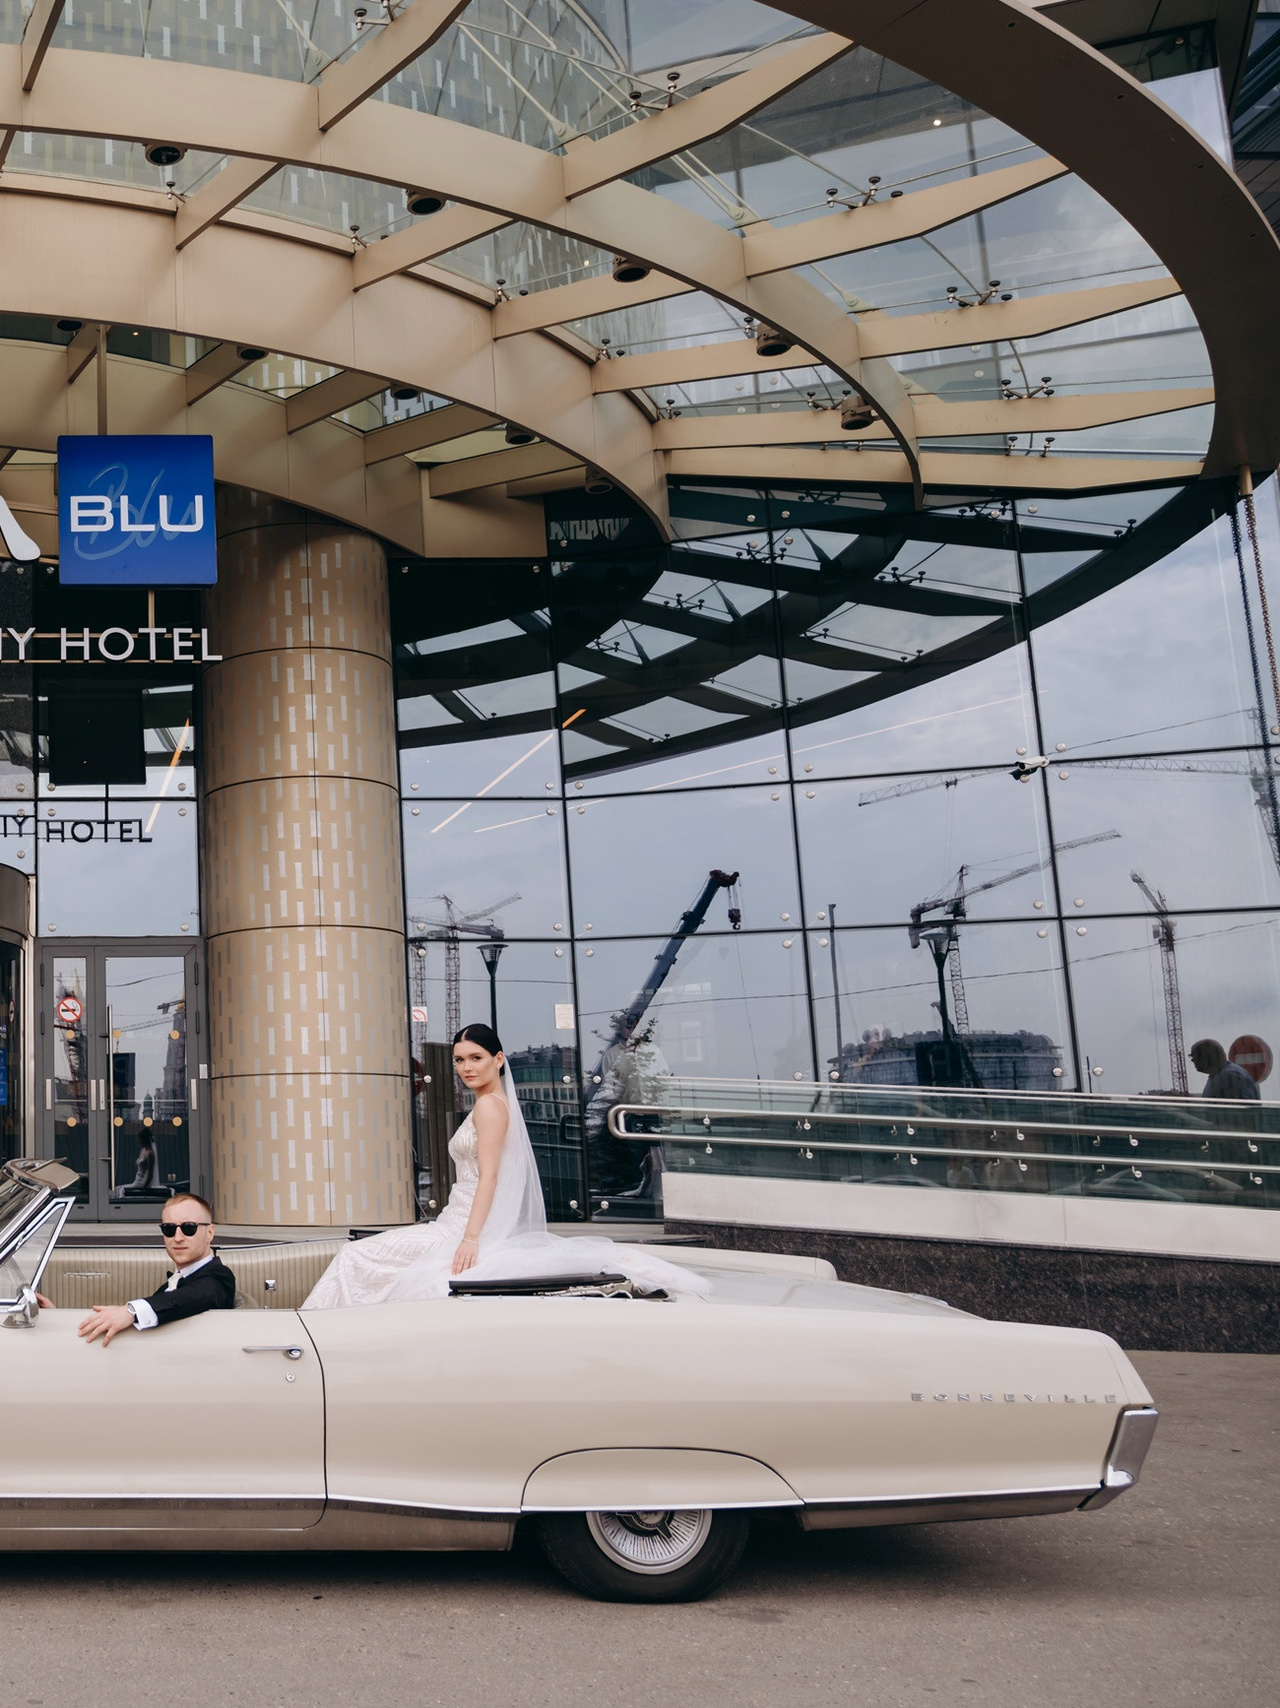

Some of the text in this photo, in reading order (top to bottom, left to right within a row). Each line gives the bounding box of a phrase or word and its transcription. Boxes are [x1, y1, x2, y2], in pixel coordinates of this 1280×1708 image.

[70, 494, 204, 532] BLU
[60, 627, 222, 661] HOTEL
[46, 818, 153, 843] HOTEL
[911, 1392, 1115, 1403] BONNEVILLE
